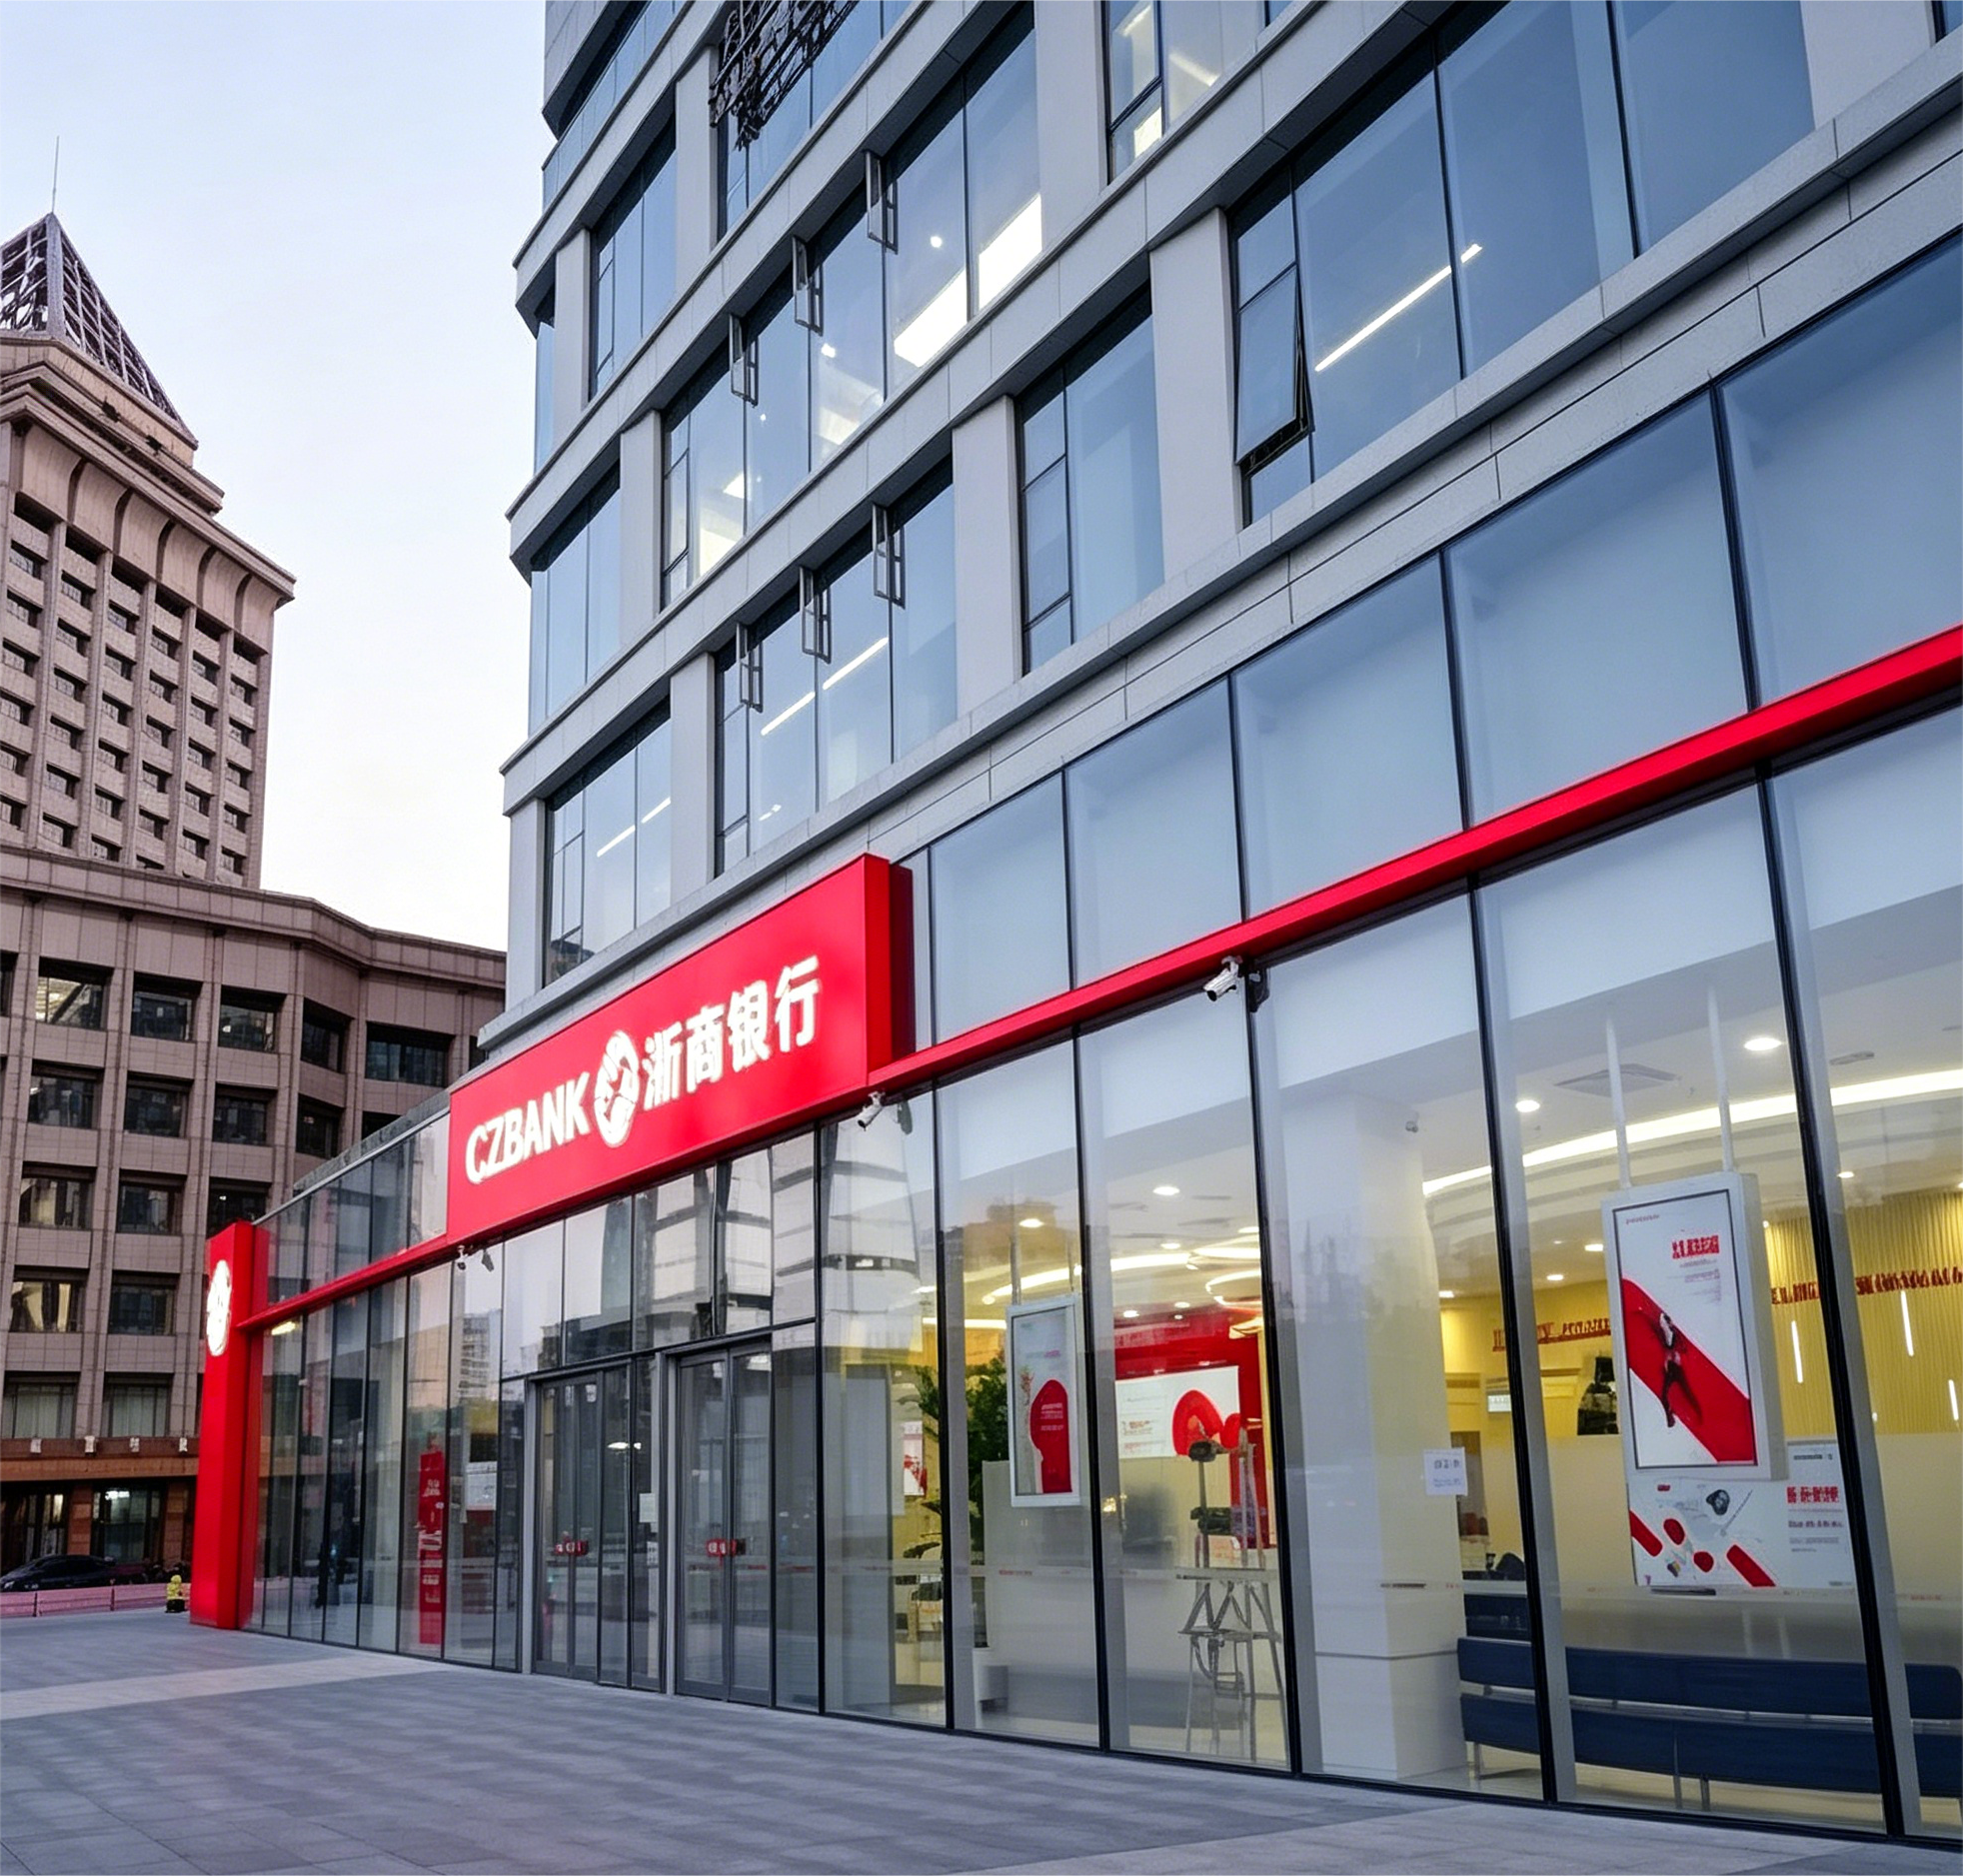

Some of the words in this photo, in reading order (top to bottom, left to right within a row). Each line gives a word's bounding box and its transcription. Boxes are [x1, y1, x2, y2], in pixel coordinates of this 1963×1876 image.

[642, 954, 820, 1111] 浙商银行
[466, 1071, 590, 1184] CZBANK
